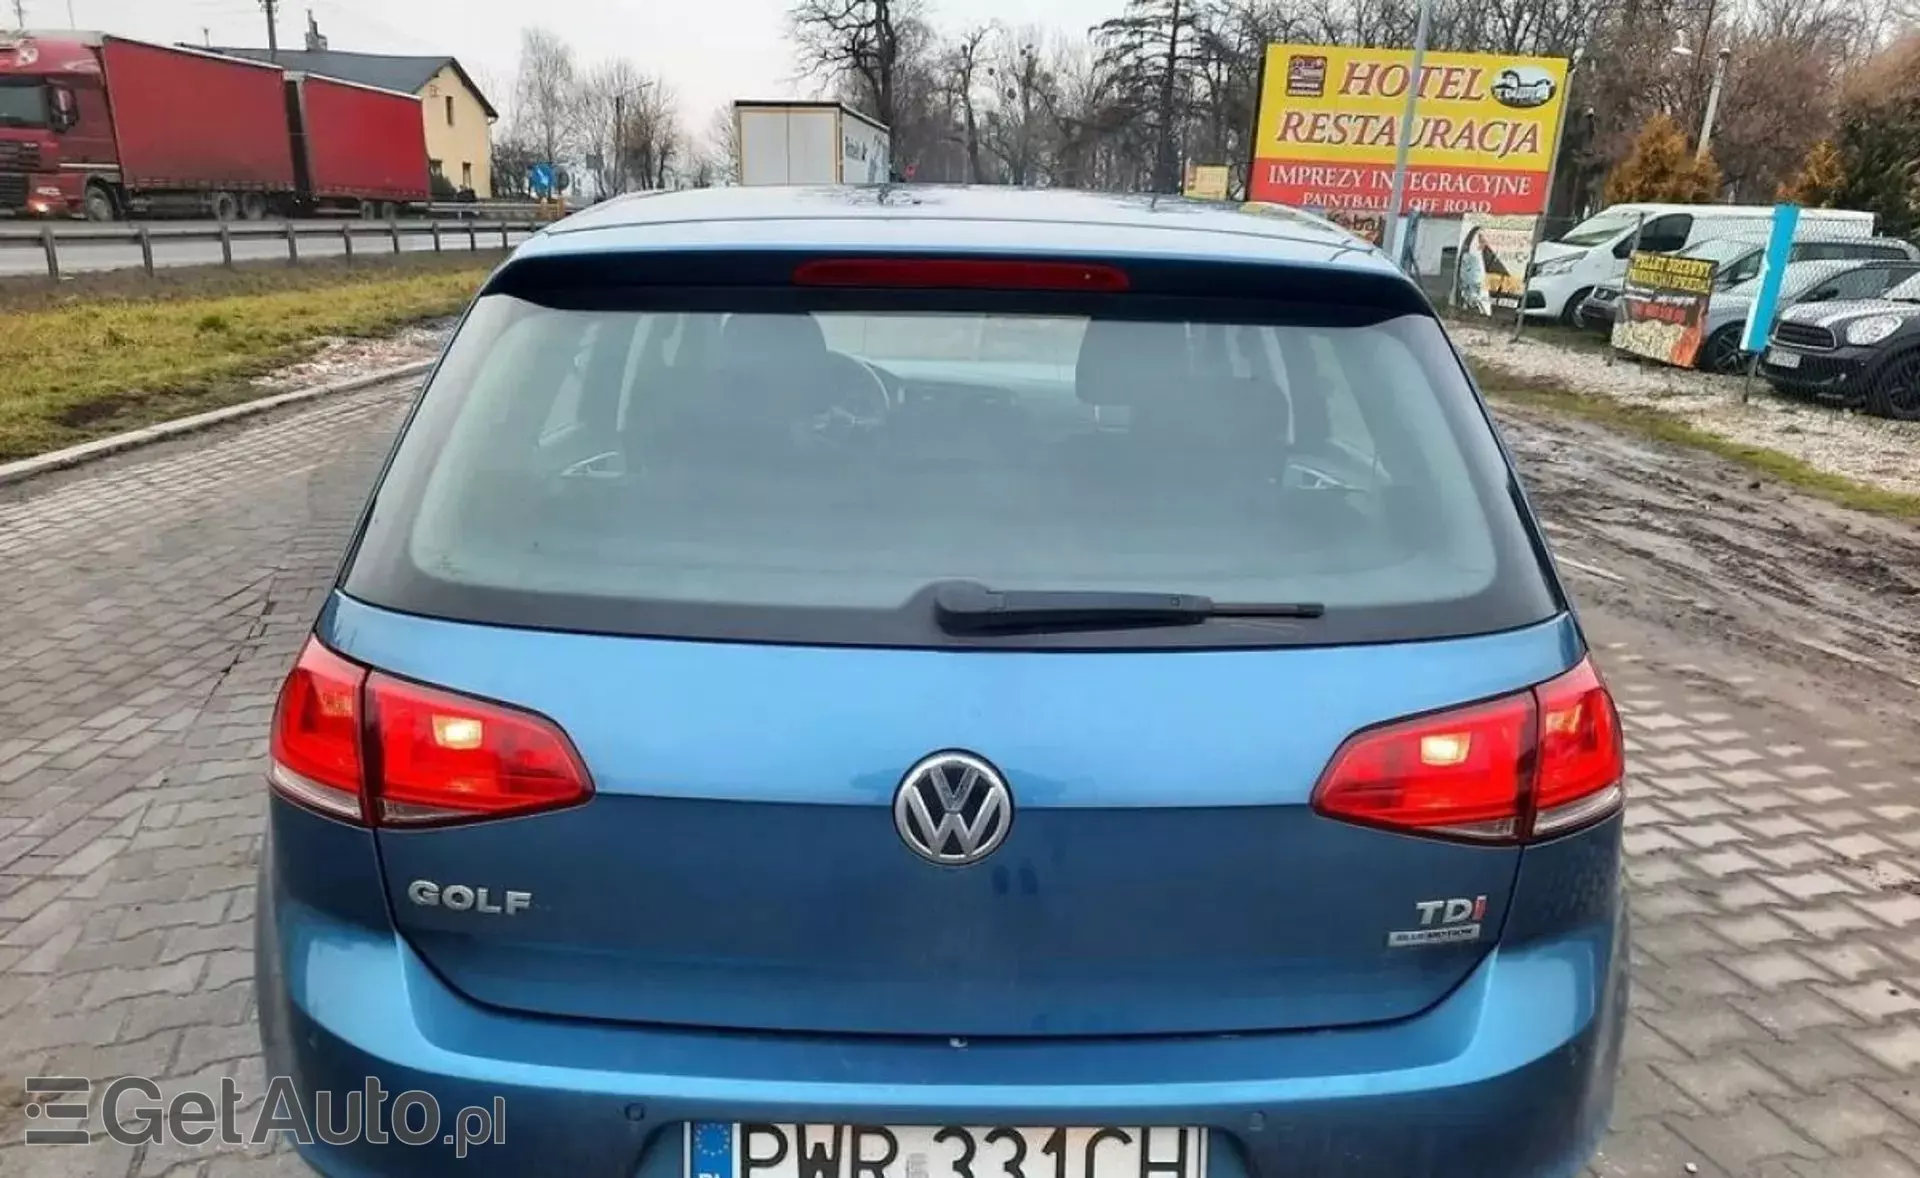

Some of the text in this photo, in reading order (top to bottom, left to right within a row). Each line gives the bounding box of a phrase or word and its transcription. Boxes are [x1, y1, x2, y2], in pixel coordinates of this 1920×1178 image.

[1338, 61, 1486, 101] HOTEL
[1268, 164, 1532, 198] IMPREZY INEGRACYJNE
[1444, 199, 1492, 214] ROAD
[408, 879, 532, 915] GOLF
[741, 1123, 1188, 1178] PWR 331CH
